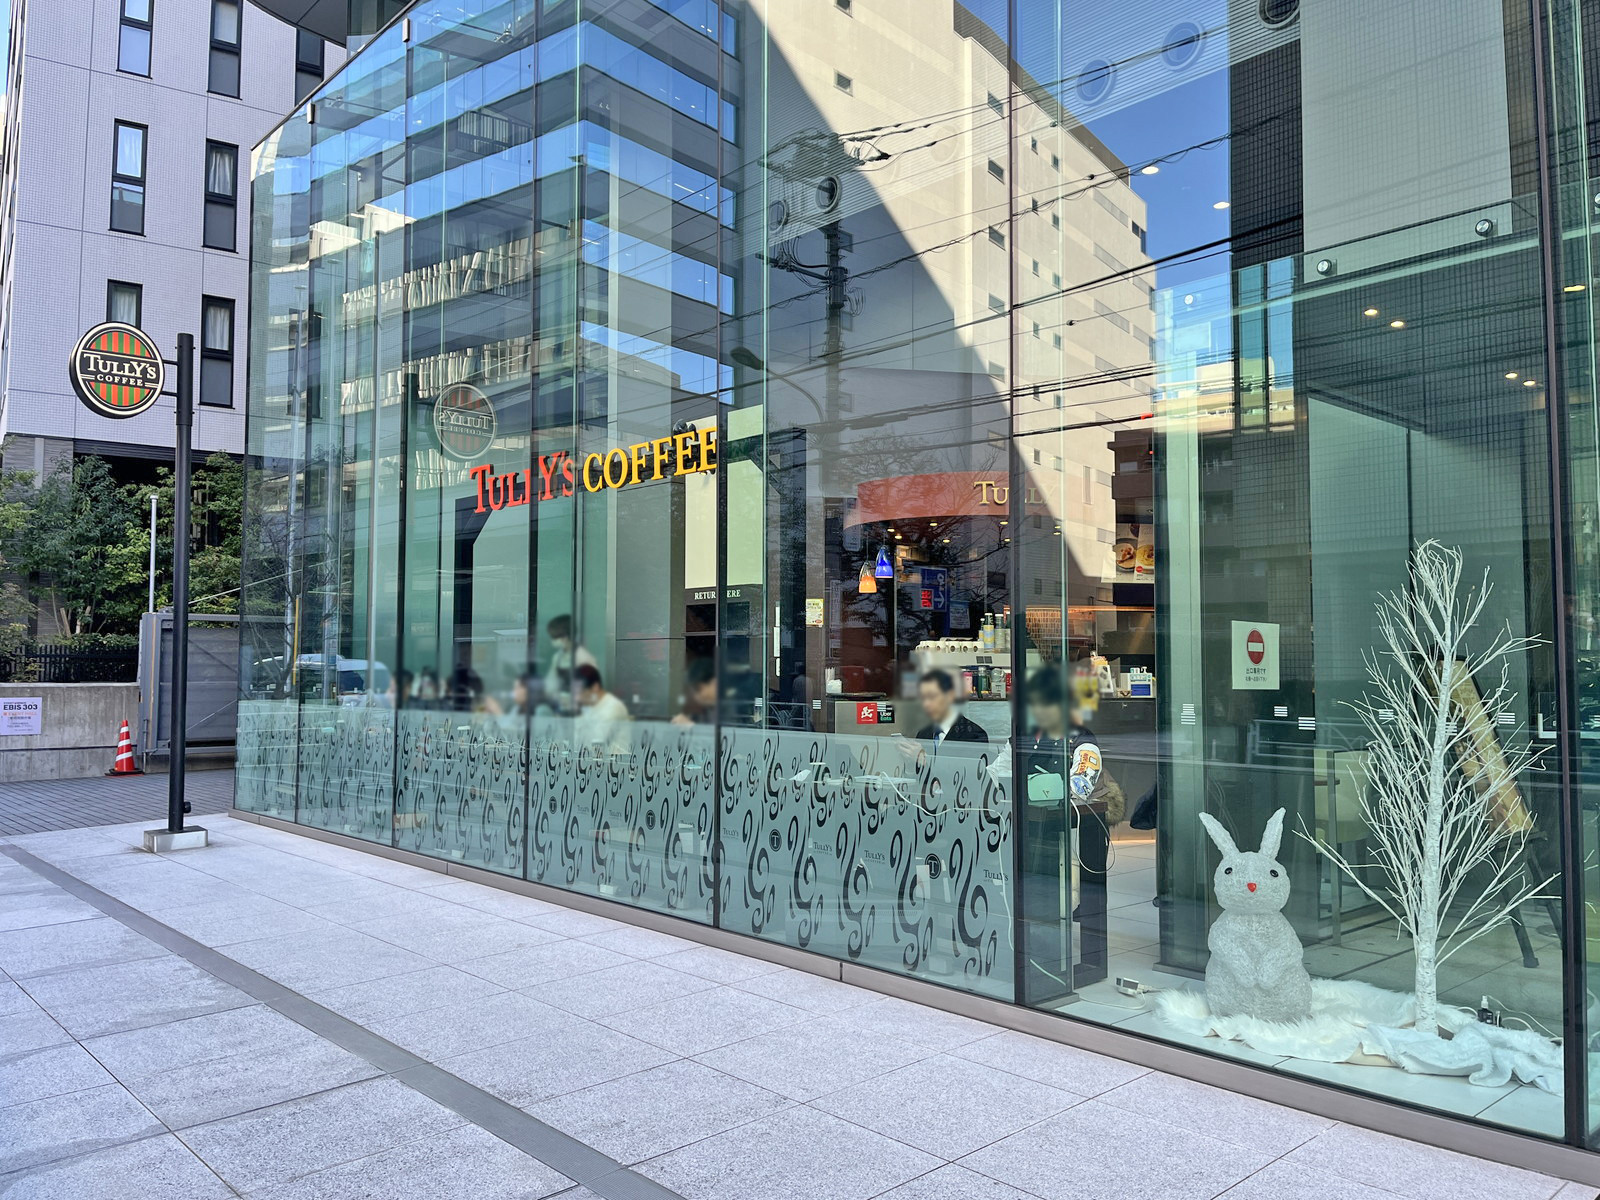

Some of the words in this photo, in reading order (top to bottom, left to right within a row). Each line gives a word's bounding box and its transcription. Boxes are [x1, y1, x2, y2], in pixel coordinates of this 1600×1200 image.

[96, 373, 144, 387] COFFEE
[582, 426, 717, 493] COFFEE
[694, 591, 717, 600] RETUR
[726, 589, 741, 598] ERE
